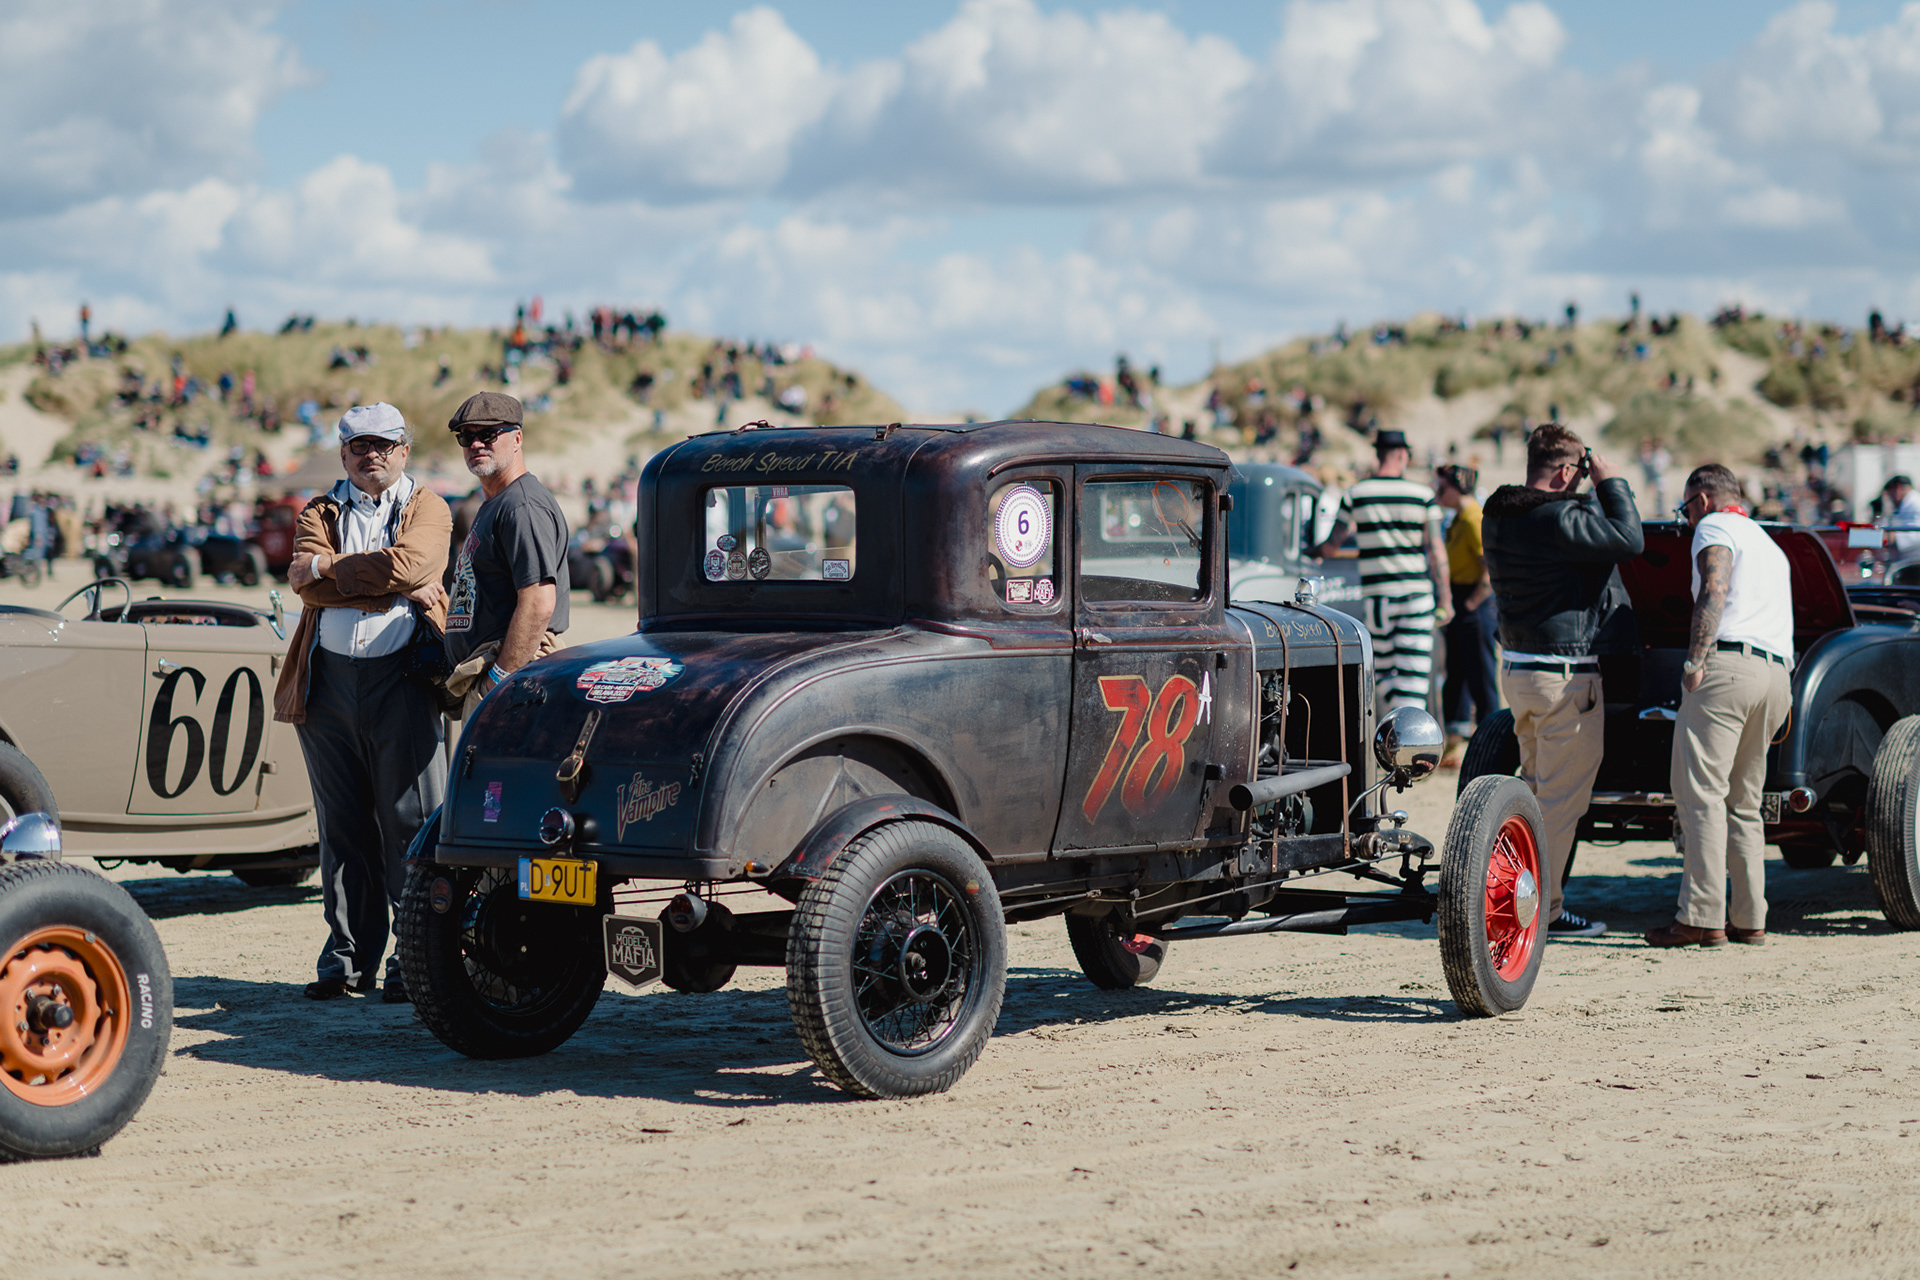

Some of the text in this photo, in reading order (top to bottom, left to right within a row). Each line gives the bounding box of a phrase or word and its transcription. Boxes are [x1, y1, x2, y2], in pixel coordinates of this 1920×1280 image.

[701, 450, 859, 475] Beech Speed T/A
[772, 487, 789, 498] VHRA
[1017, 510, 1030, 536] 6
[146, 667, 264, 799] 60
[1083, 670, 1213, 825] 78 A
[616, 781, 682, 843] Vampire
[520, 863, 592, 899] PL D 9UT
[612, 944, 656, 966] MAFIA
[136, 974, 154, 1029] RACING
